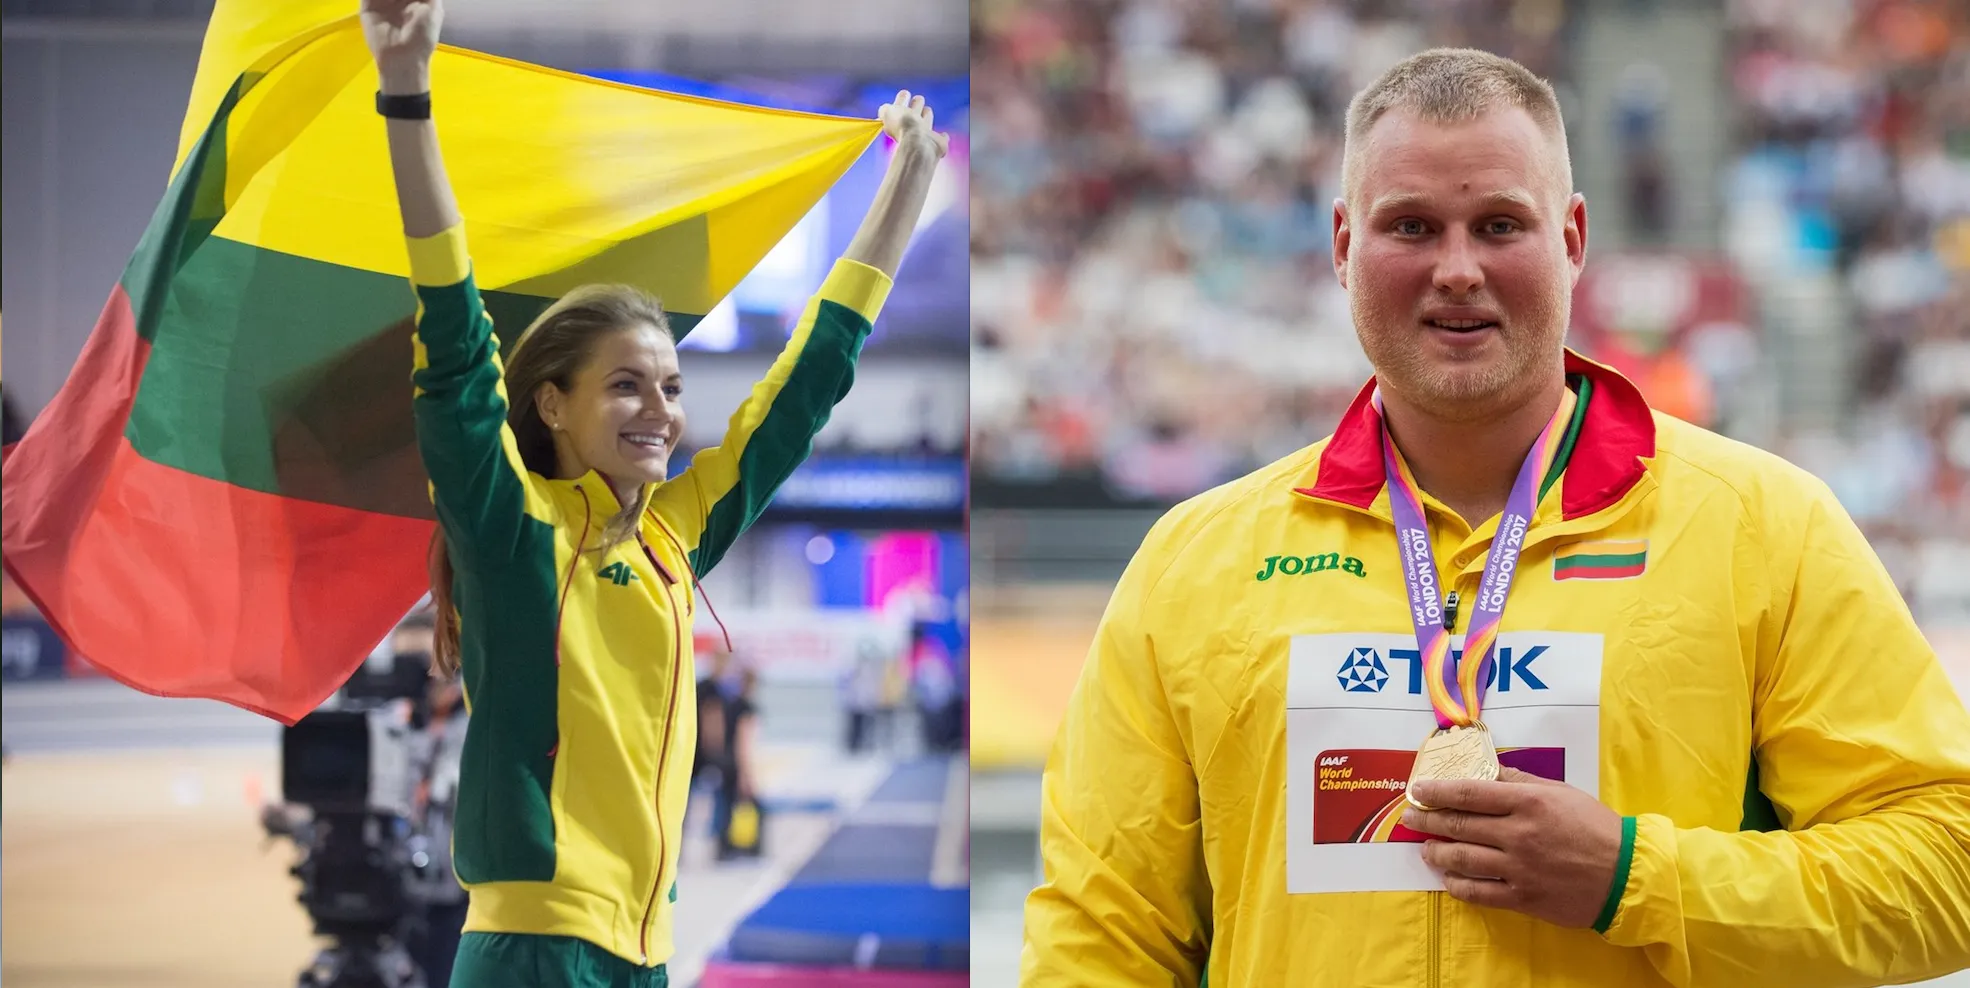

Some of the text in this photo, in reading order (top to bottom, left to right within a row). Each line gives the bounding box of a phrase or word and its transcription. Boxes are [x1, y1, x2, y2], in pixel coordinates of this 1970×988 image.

[1256, 552, 1367, 581] Joma
[1402, 529, 1426, 626] IAAF World Championships
[1410, 528, 1442, 625] LONDON 2017
[1479, 514, 1514, 611] IAAF World Championships
[1488, 514, 1527, 613] LONDON 2017
[1389, 645, 1551, 694] TK
[1320, 756, 1348, 766] IAAF
[1320, 767, 1353, 779] World
[1320, 778, 1407, 791] Championships
